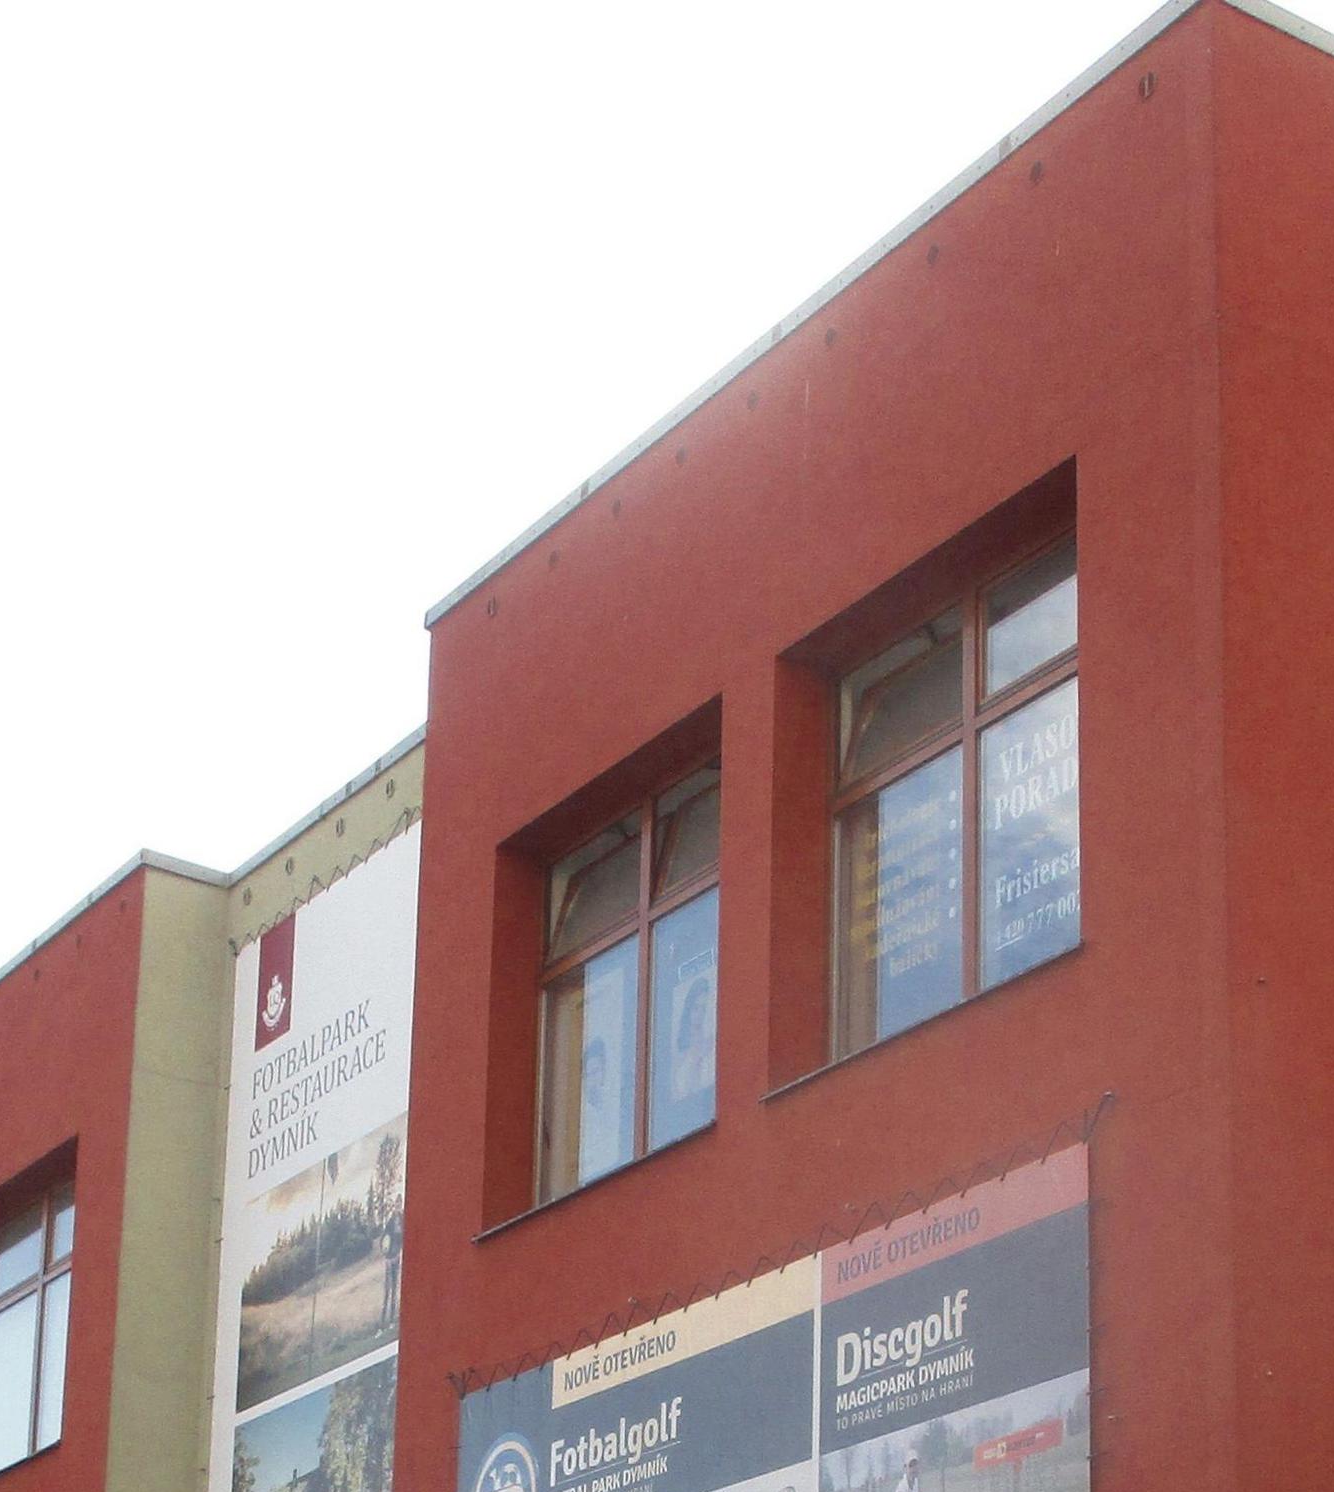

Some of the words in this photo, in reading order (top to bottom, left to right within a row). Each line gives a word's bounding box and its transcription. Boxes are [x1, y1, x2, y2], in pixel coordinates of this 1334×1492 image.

[249, 1107, 263, 1139] &
[267, 1029, 387, 1130] RESTAURACE
[252, 999, 371, 1100] FOTBALPARK
[247, 1111, 319, 1180] DYMNÍK
[837, 1242, 882, 1285] NOVĚ
[887, 1207, 981, 1264] OTEVŘENO
[563, 1355, 600, 1392] NOVĚ
[602, 1330, 677, 1375] OTEVŘENO
[836, 1288, 969, 1388] Discgolf
[836, 1368, 915, 1414] MAGICPARK
[918, 1345, 974, 1387] DYMNÍK
[921, 1387, 936, 1404] NA
[549, 1396, 683, 1488] Fotbalgolf
[622, 1453, 669, 1485] DYMNÍK
